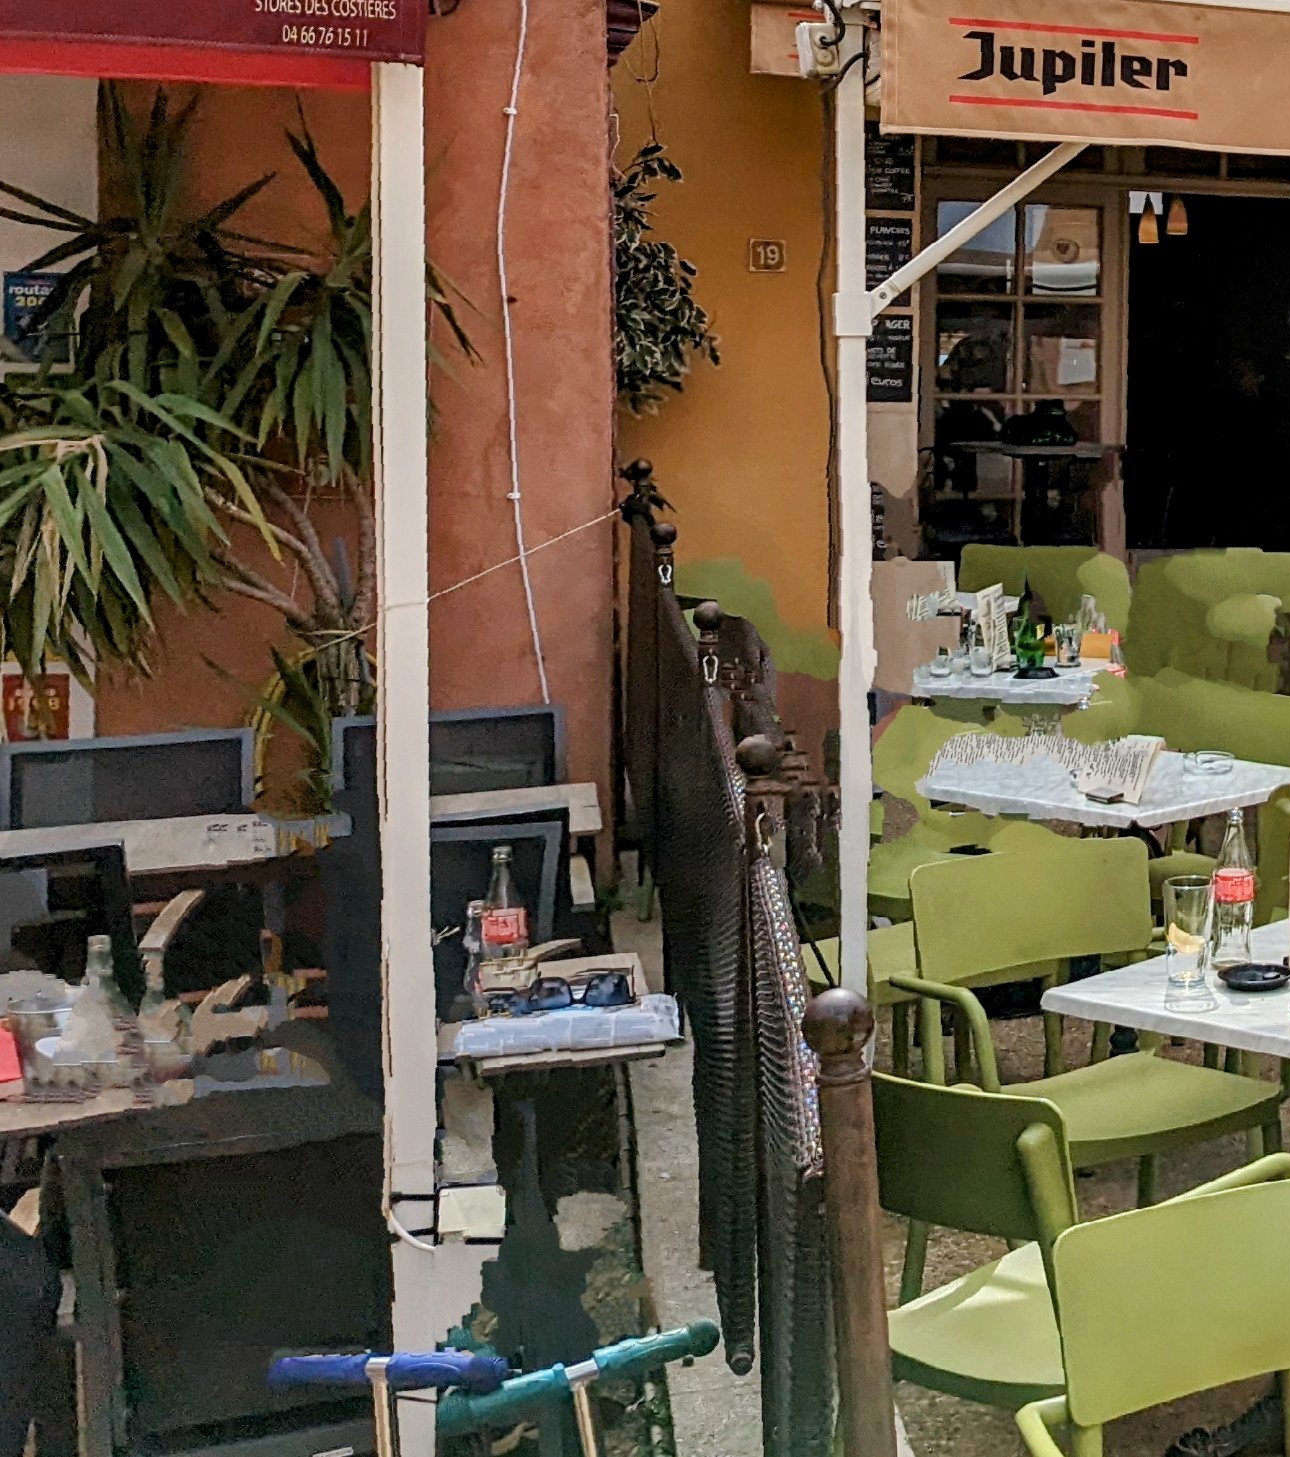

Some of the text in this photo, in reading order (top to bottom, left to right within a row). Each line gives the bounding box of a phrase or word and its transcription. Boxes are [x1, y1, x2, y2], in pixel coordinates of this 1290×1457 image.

[282, 24, 368, 47] 04 66 76 15 11
[956, 30, 1190, 95] Jupiler
[757, 245, 780, 265] 19
